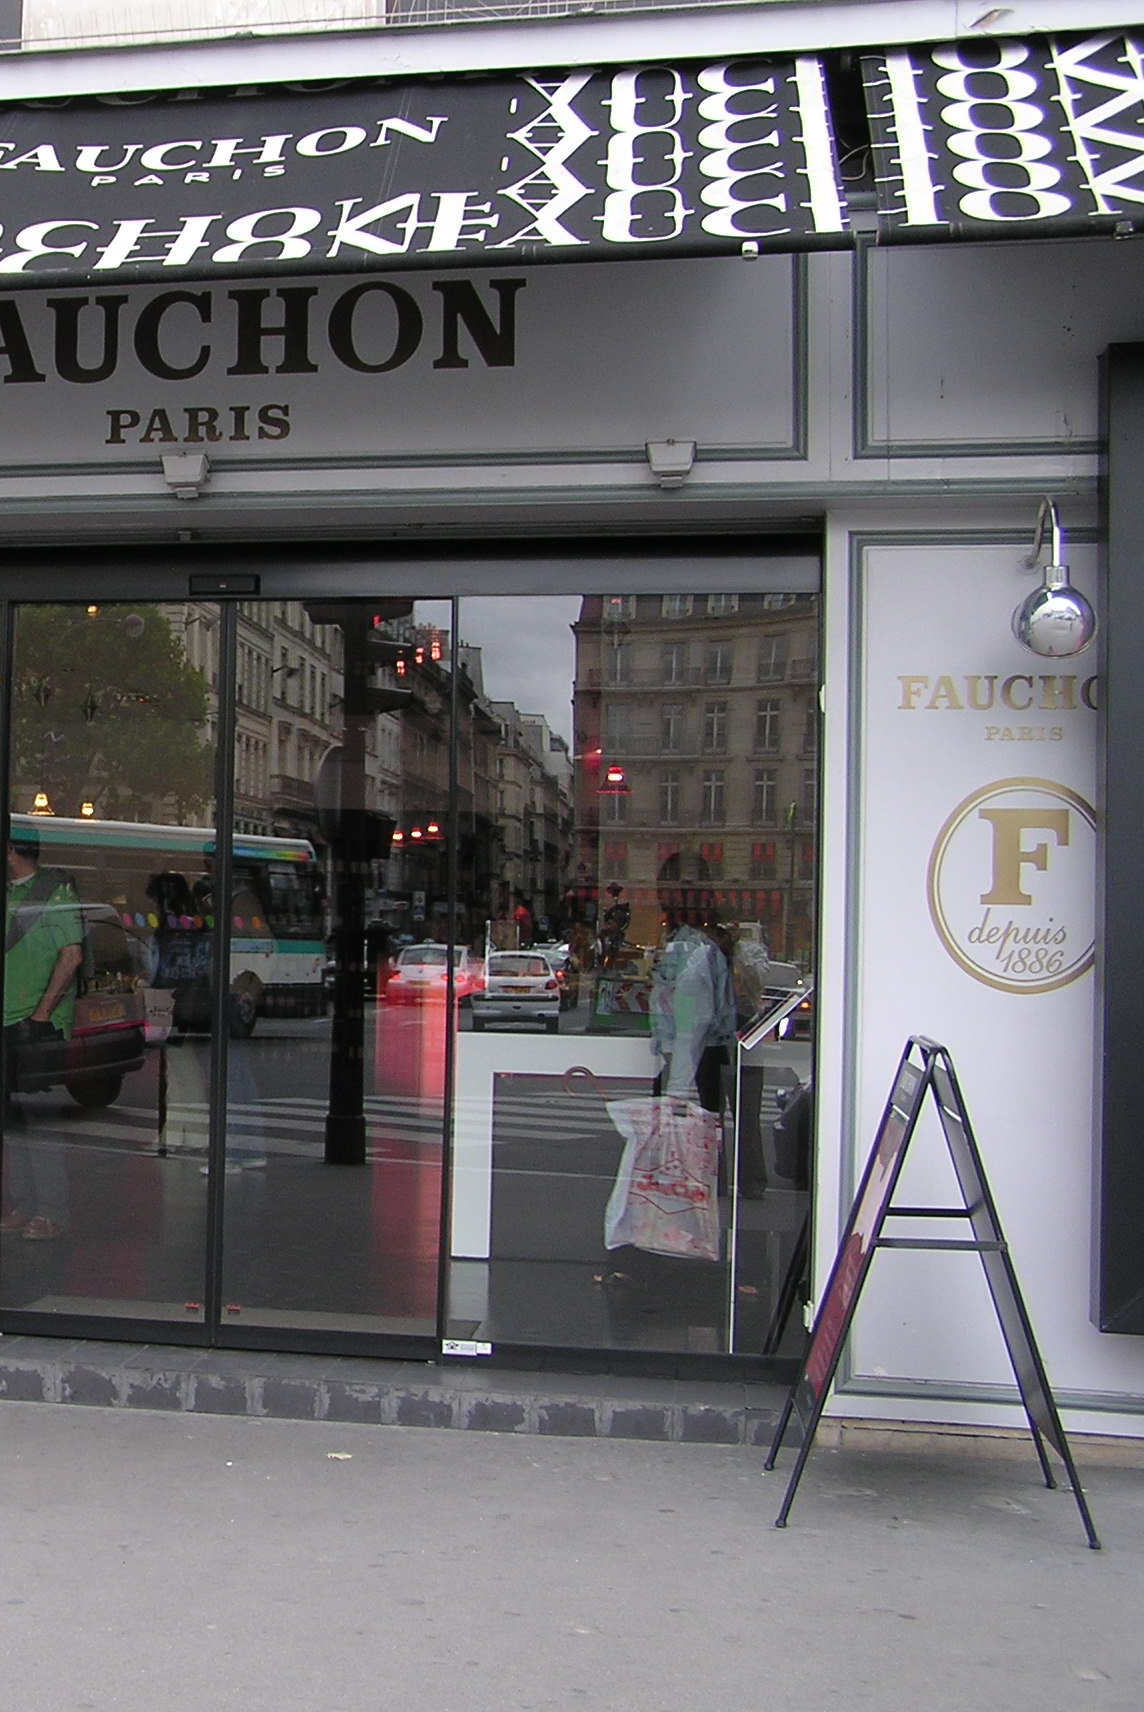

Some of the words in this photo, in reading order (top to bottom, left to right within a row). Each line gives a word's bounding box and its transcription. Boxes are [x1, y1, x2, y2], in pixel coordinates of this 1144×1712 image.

[91, 164, 287, 187] PARIS
[104, 403, 291, 444] PARIS
[984, 726, 1064, 741] PARIS
[978, 807, 1070, 906] F
[967, 907, 1067, 960] depuis
[1000, 947, 1064, 974] 1886
